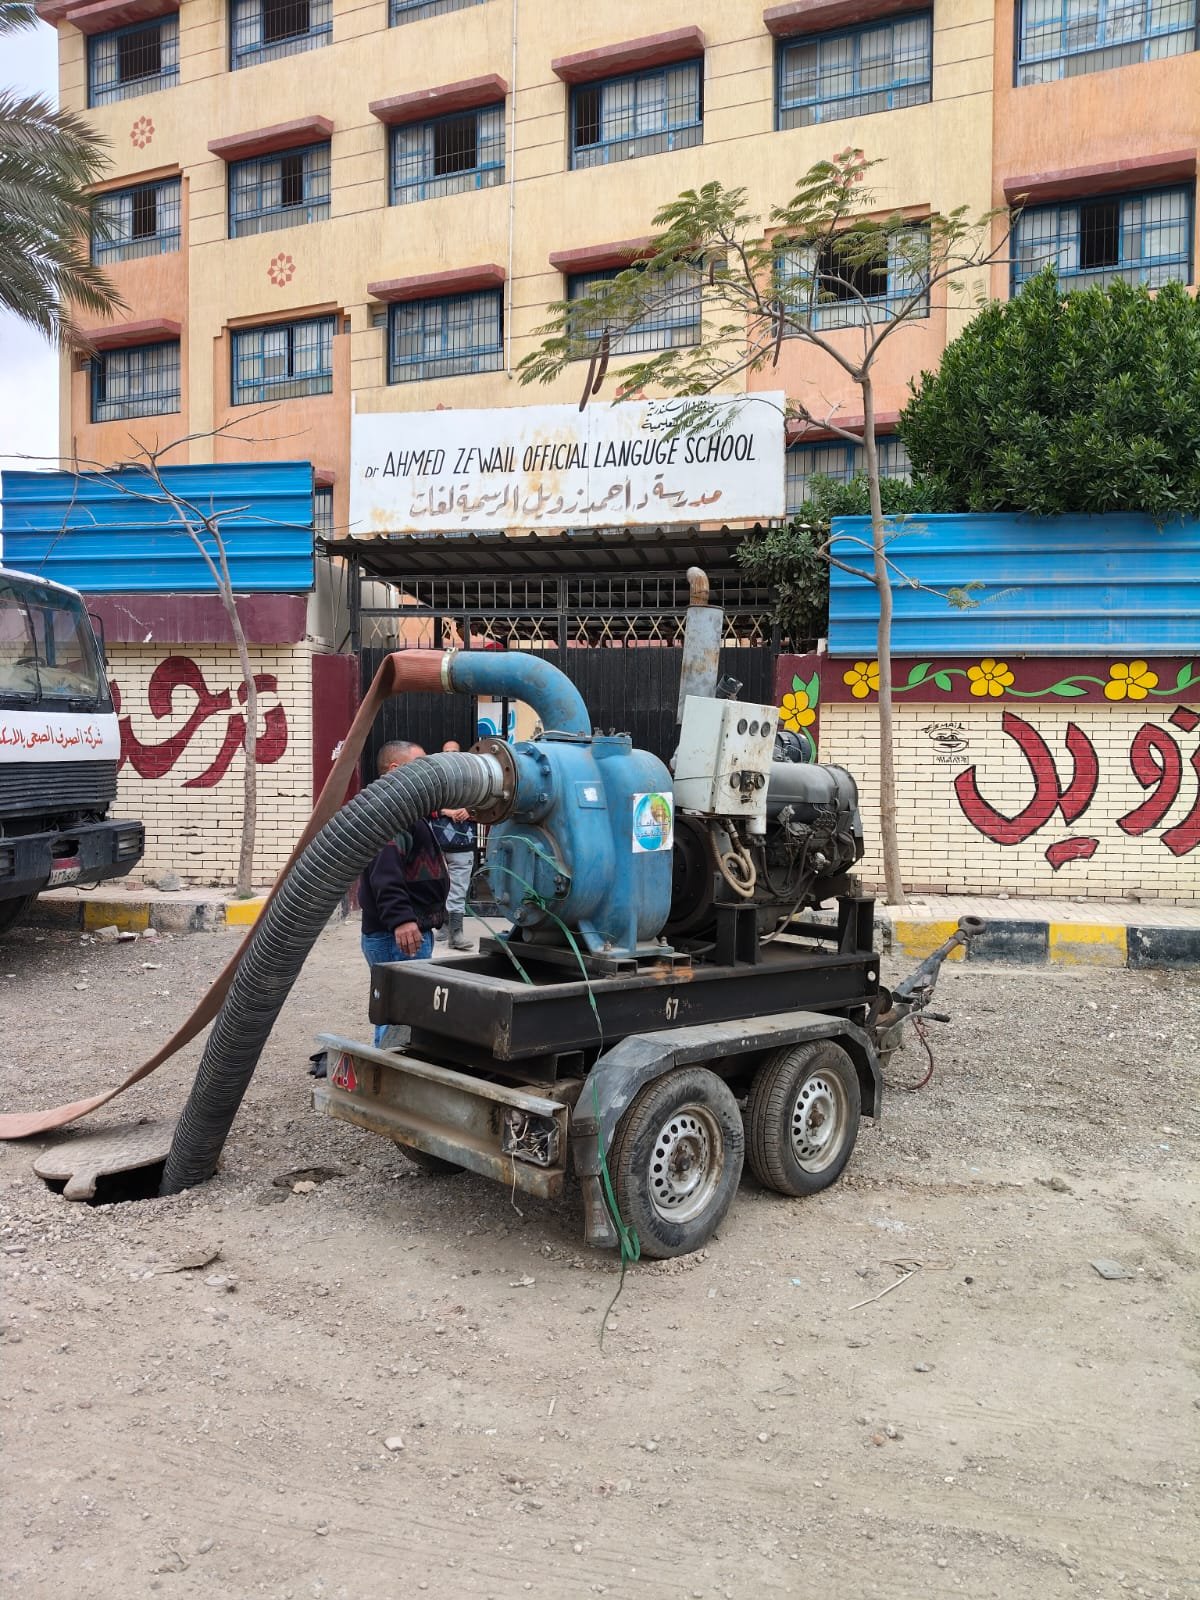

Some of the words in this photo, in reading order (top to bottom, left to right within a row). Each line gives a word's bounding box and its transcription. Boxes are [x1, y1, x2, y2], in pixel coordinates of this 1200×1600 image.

[365, 466, 379, 478] Dr
[383, 449, 446, 477] AHMED
[453, 446, 515, 474] ZEWAIL
[523, 442, 589, 471] OFFICIAL
[594, 438, 680, 467] LANGUGE
[684, 433, 756, 464] SCHOOL
[409, 484, 455, 517] لغات
[457, 483, 519, 521] الرسمية
[653, 473, 722, 508] مدرسة
[55, 727, 83, 749] الصرف
[84, 725, 103, 749] شركة
[433, 985, 448, 1012] 67
[666, 996, 679, 1020] 67
